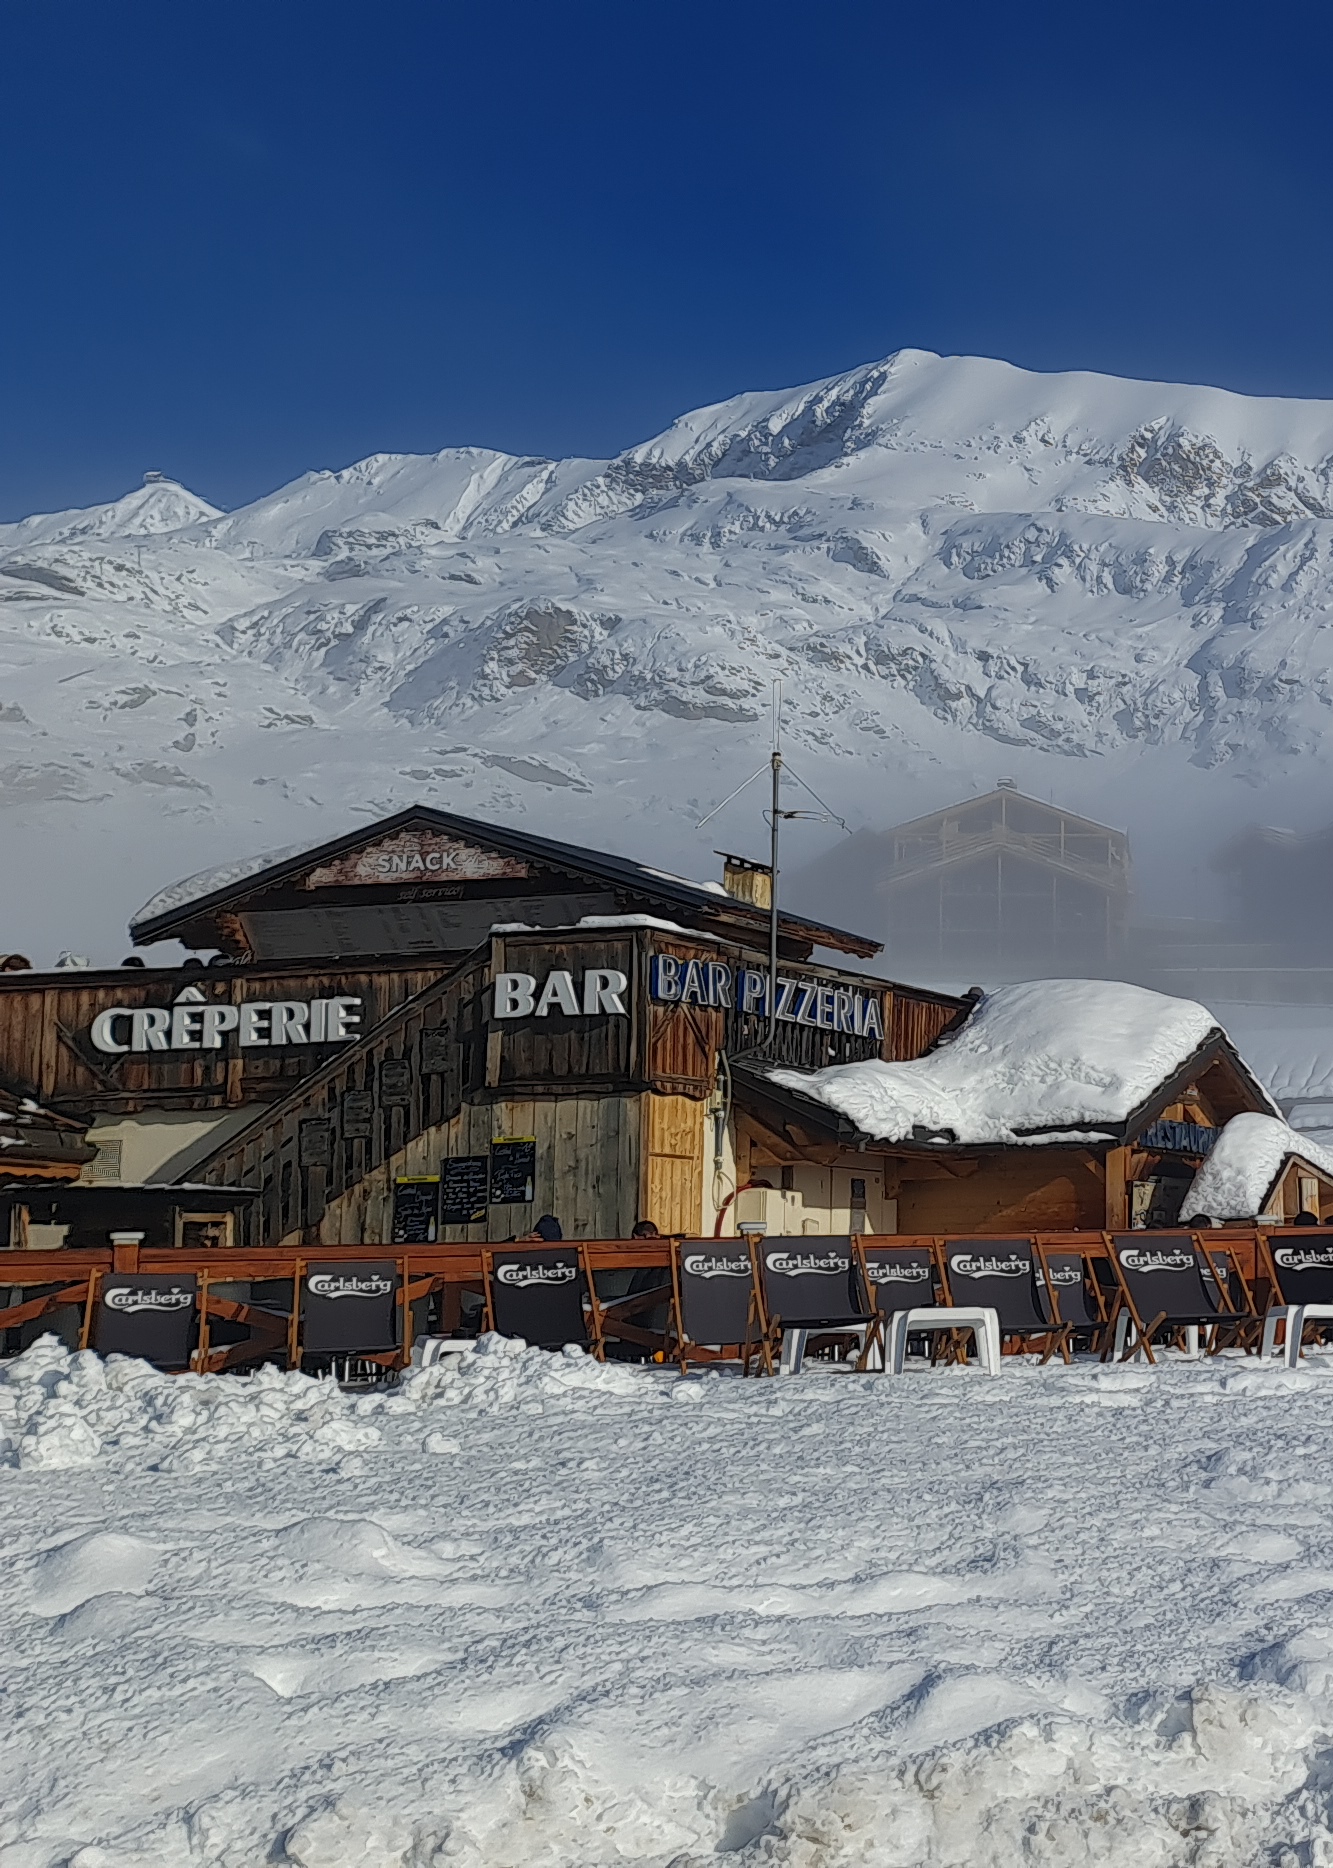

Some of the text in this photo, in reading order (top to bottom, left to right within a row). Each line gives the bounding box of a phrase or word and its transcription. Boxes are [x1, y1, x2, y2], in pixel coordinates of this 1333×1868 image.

[377, 852, 457, 872] SNACK
[494, 969, 629, 1019] BAR
[657, 953, 885, 1041] BAR PIZZERIA
[91, 986, 362, 1054] CRÊPERIE
[766, 1252, 849, 1277] Carlsberg
[951, 1254, 1030, 1279] Carlsberg
[1119, 1249, 1194, 1273] Carlsberg
[308, 1274, 392, 1299] Carlsberg
[497, 1262, 577, 1287] Carlsberg
[105, 1287, 193, 1313] Carlsberg
